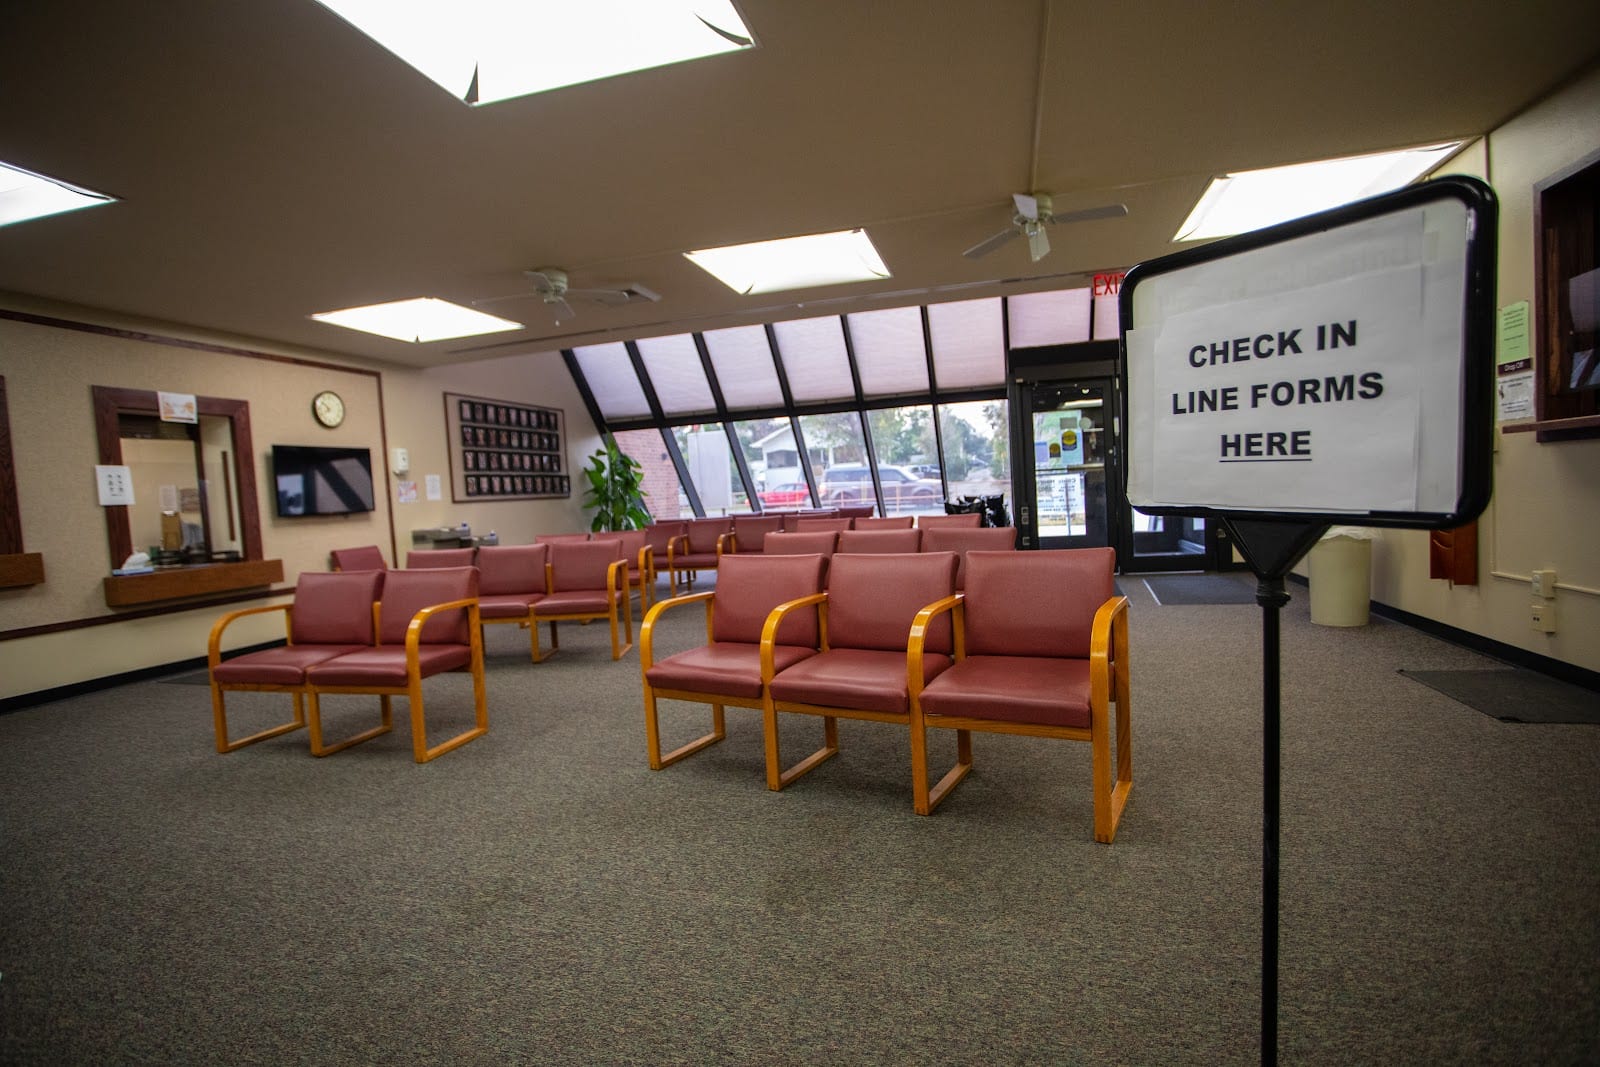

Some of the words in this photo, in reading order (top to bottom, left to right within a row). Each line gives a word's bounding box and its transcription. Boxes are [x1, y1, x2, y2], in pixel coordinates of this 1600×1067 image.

[1188, 328, 1303, 368] CHECK
[1316, 319, 1358, 352] IN
[1172, 383, 1239, 415] LINE
[1250, 371, 1385, 409] FORMS
[1219, 430, 1313, 461] HERE
